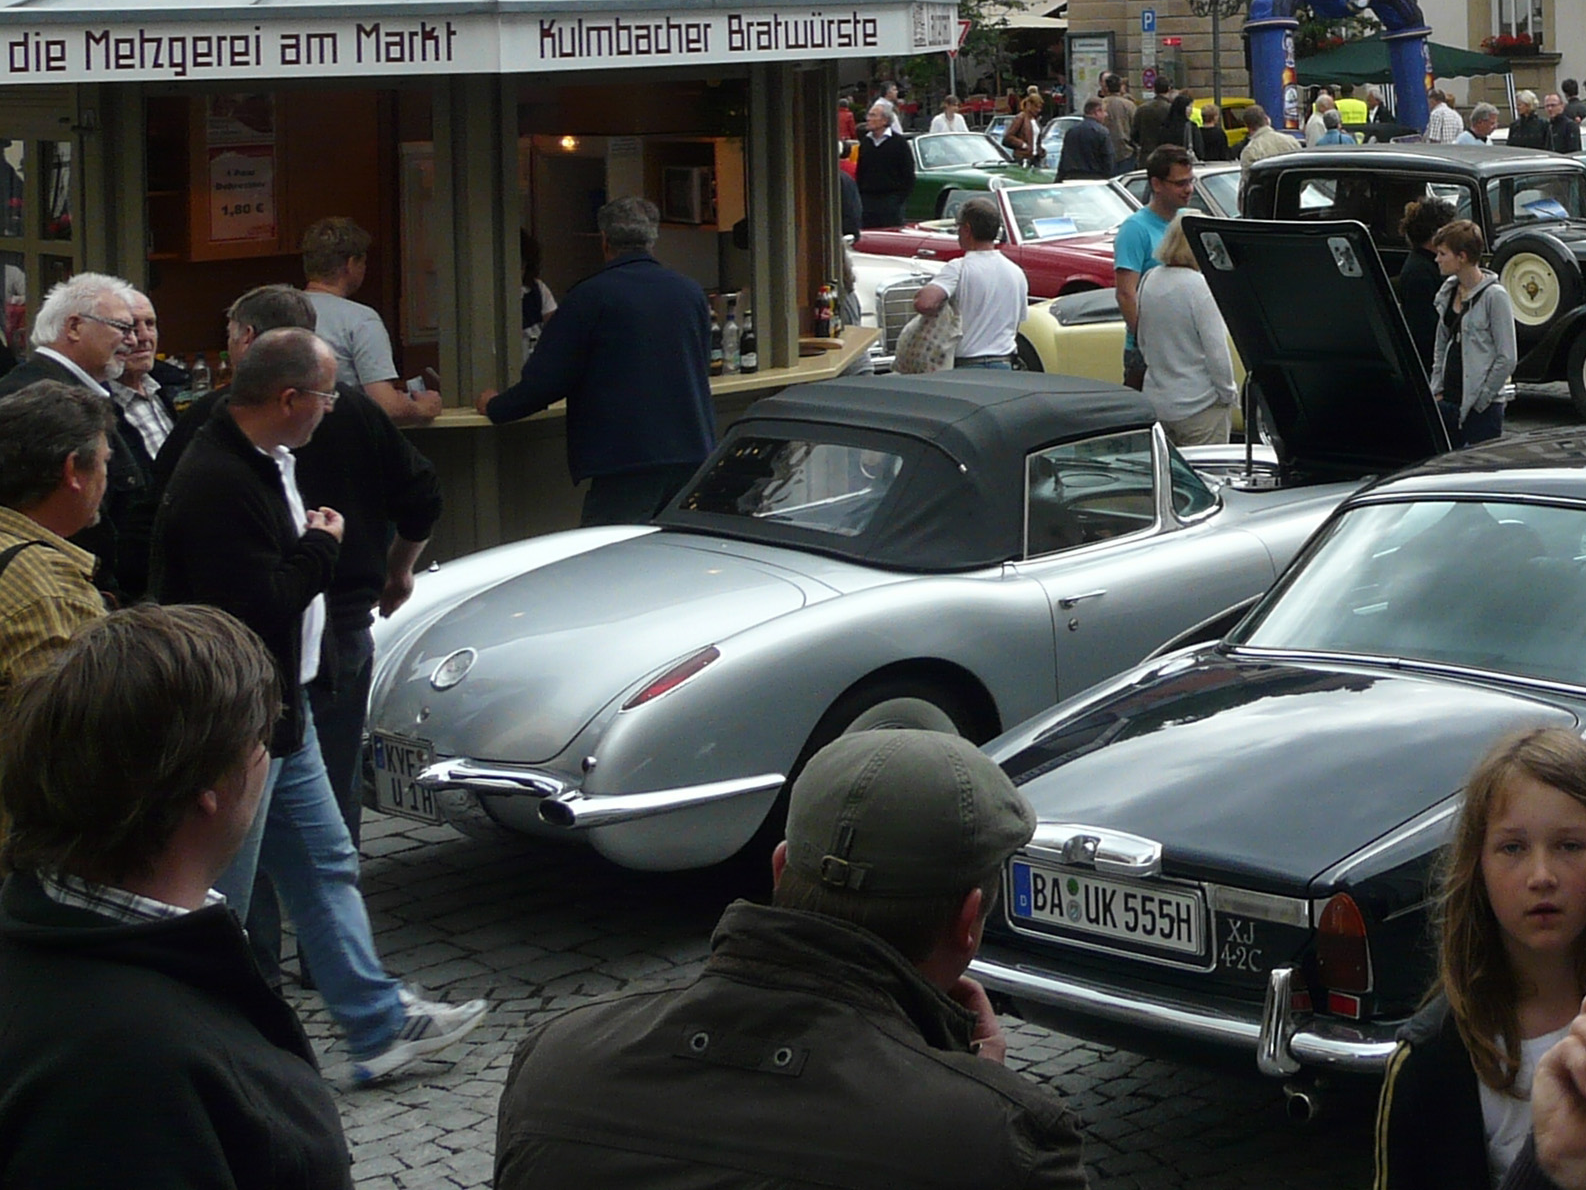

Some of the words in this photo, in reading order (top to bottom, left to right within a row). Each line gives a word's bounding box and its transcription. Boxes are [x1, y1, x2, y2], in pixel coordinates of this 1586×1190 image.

[538, 16, 712, 60] Kulmbacher
[727, 10, 878, 53] Bratwürste
[1144, 12, 1153, 30] P
[8, 30, 68, 74] die
[84, 25, 263, 77] Metzgerei
[280, 31, 338, 66] am
[354, 20, 458, 64] Markt
[221, 203, 251, 217] 1,80
[255, 202, 265, 213] €
[385, 743, 415, 778] KYF
[1019, 894, 1028, 907] D
[1032, 872, 1065, 918] BA
[1084, 883, 1118, 929] UK
[1123, 891, 1193, 943] 555H
[1226, 917, 1257, 945] XJ
